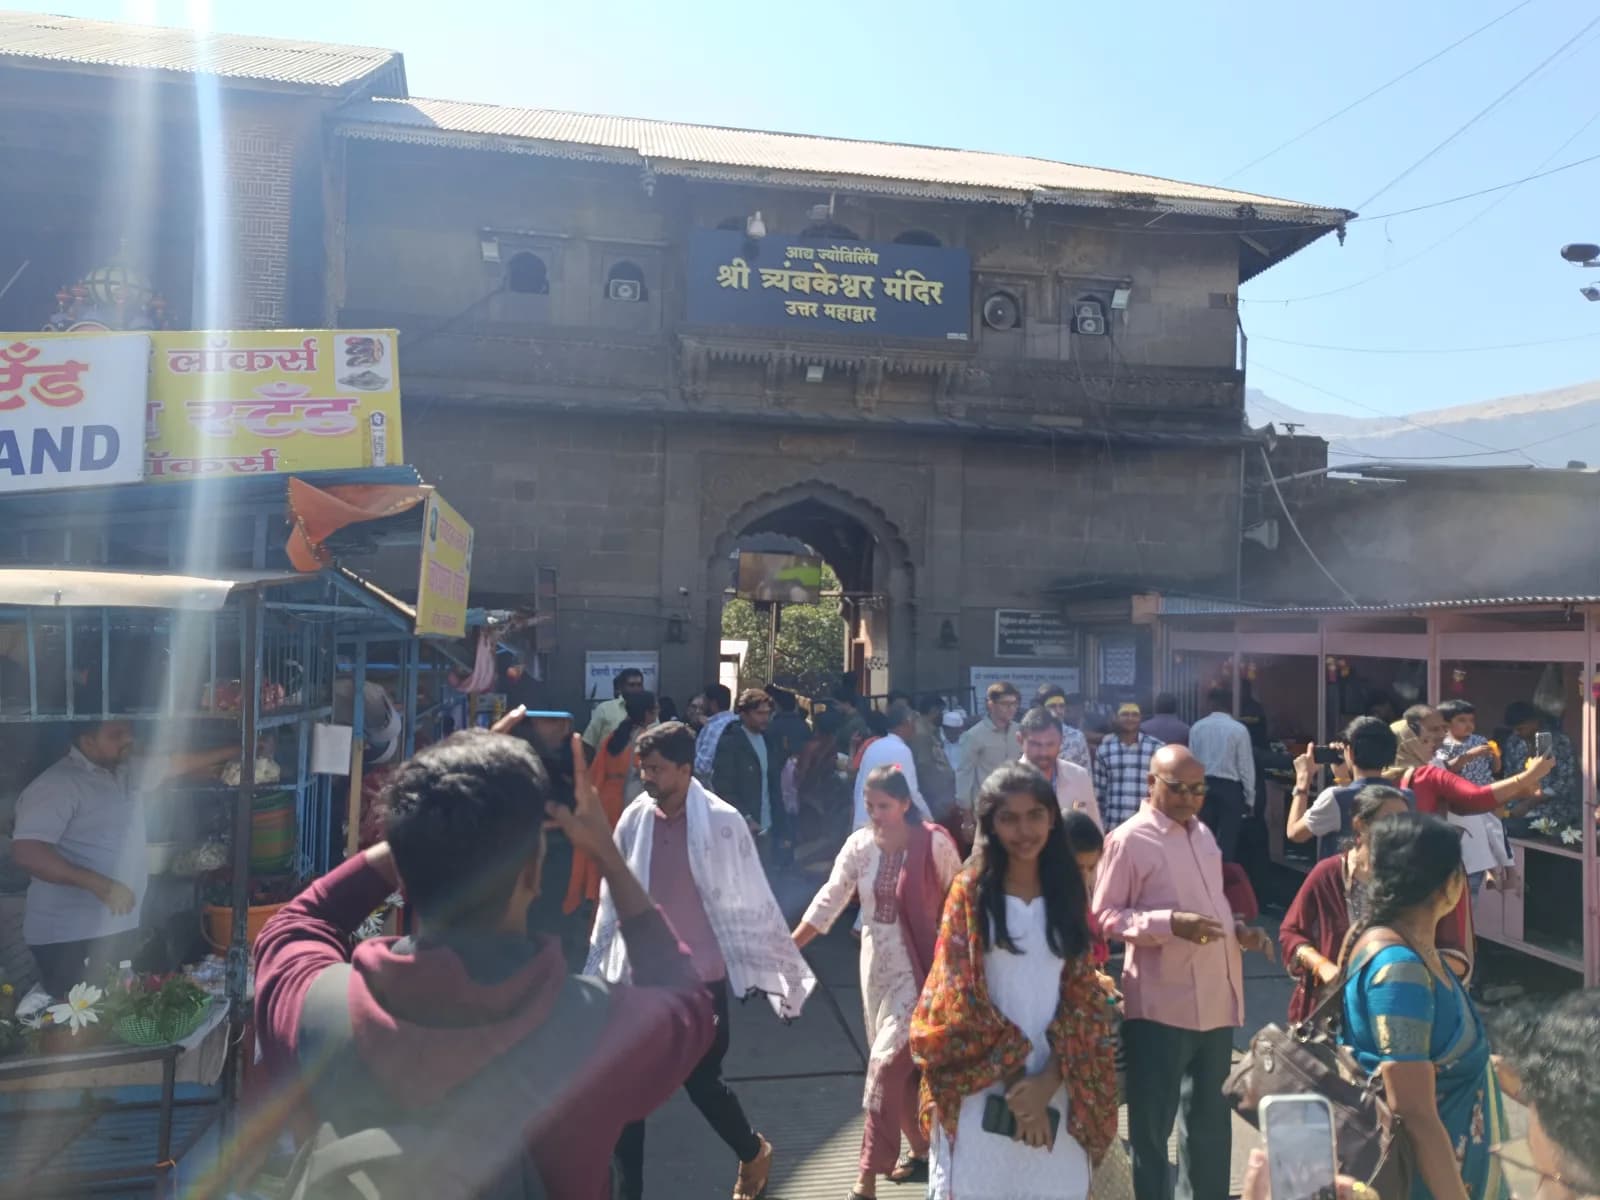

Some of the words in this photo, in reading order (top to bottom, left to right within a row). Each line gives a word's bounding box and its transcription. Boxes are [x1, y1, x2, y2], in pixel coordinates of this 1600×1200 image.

[785, 246, 814, 260] आद्य
[716, 257, 751, 289] श्री
[882, 270, 944, 304] मंदिर
[784, 300, 818, 318] उत्तर
[823, 303, 877, 323] महाद्वार
[167, 337, 319, 373] लॉकर्स
[144, 448, 279, 476] ॉकर्स
